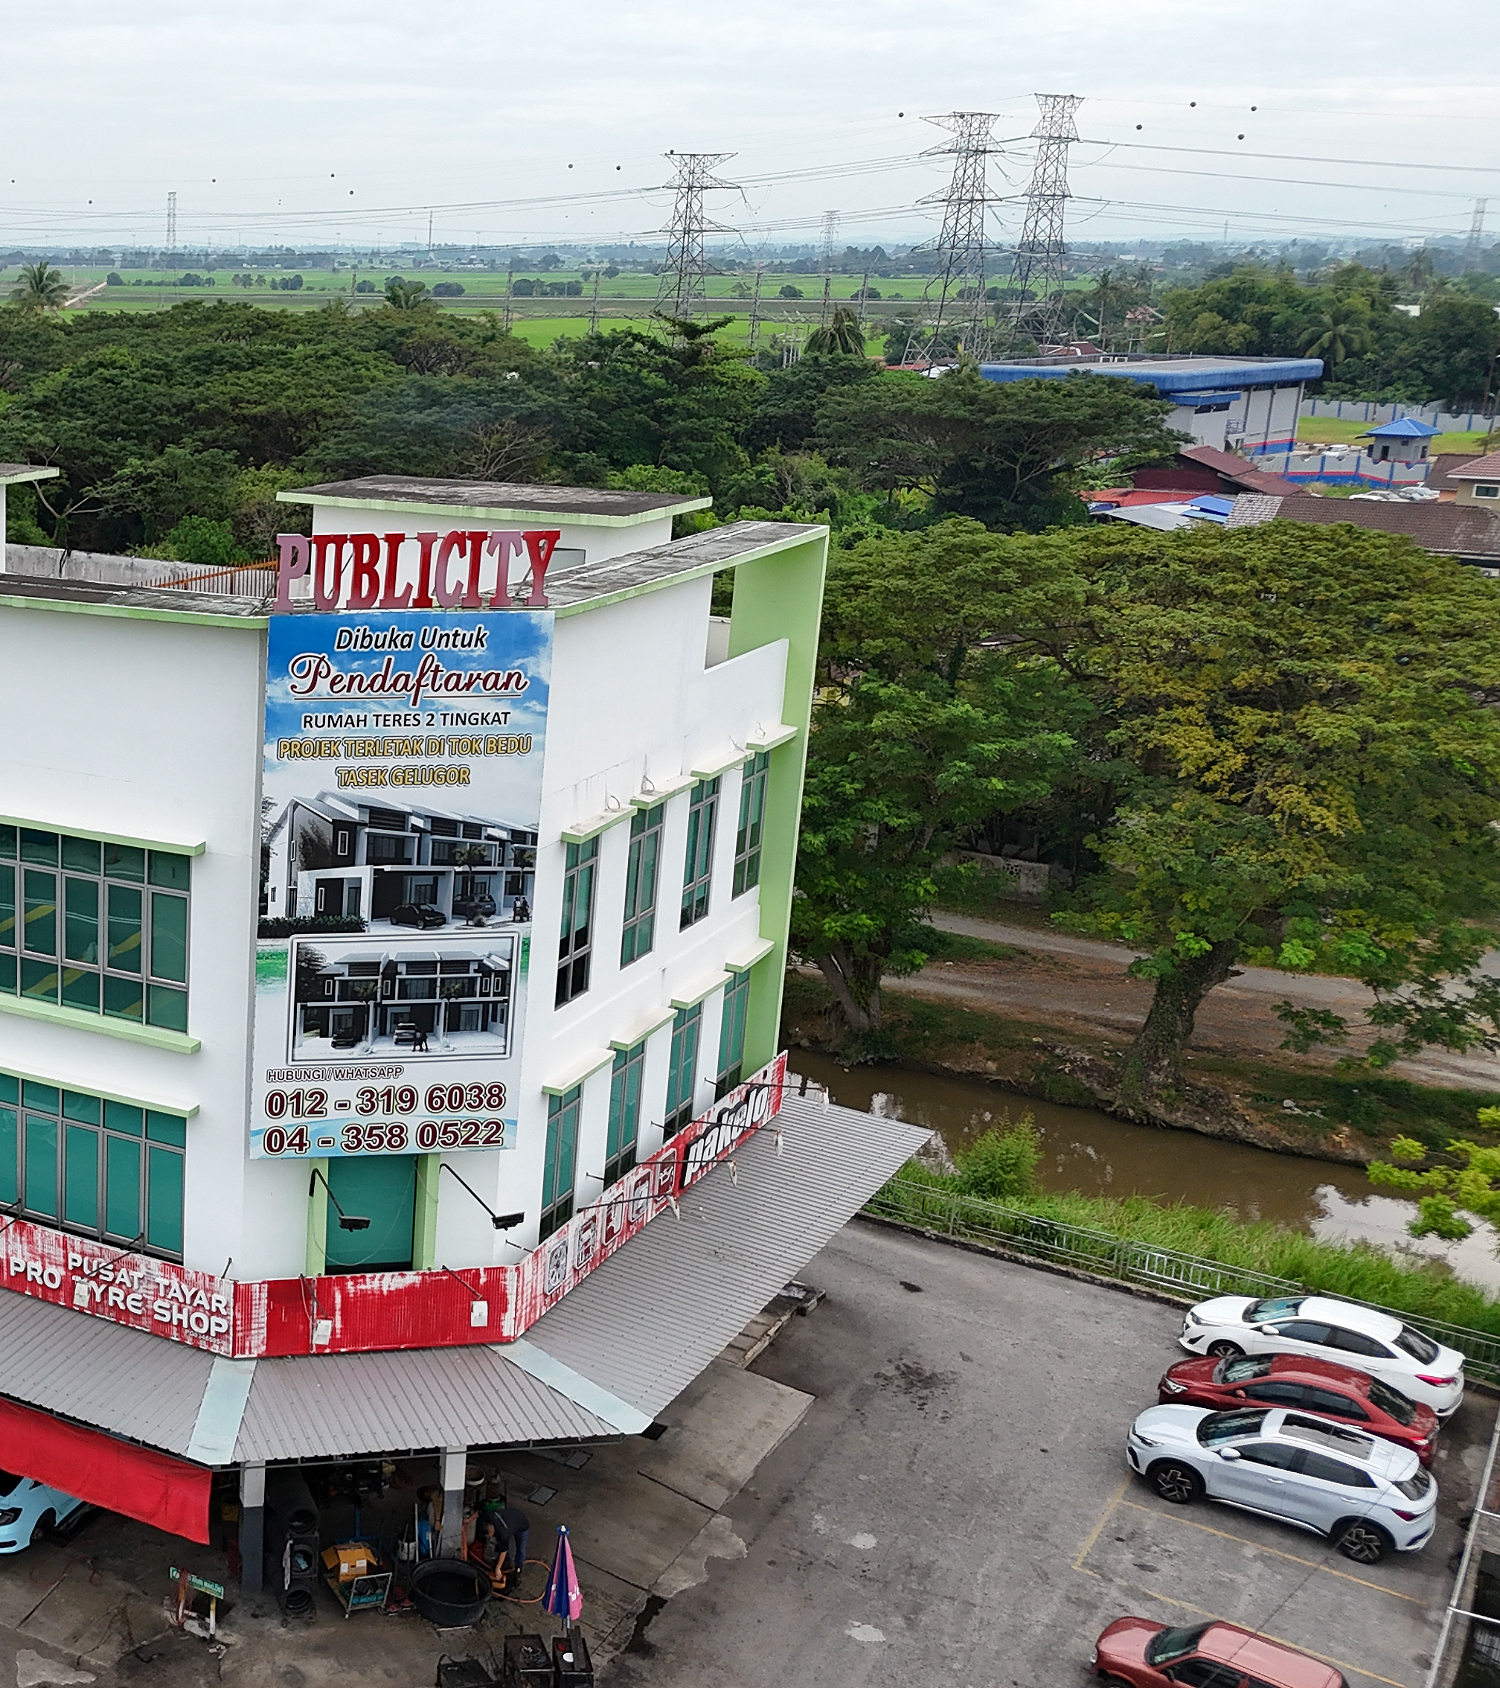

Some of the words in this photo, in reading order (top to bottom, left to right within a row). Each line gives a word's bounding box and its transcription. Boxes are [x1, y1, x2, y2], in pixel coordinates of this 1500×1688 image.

[273, 530, 560, 611] PUBLICITY
[336, 627, 413, 650] Dibuka
[420, 625, 488, 650] Untuk
[289, 653, 528, 707] Pendaftaran
[302, 713, 368, 729] RUMAH
[373, 713, 421, 728] TERES
[425, 713, 435, 727] 2
[440, 711, 511, 727] TINGKAT
[278, 739, 341, 759] PROJEK
[345, 738, 424, 758] TERLETAK
[427, 738, 446, 757] DI
[449, 737, 482, 756] TOK
[486, 735, 532, 755] BEDU
[338, 768, 387, 787] TASEK
[391, 767, 470, 786] GELUGOR
[267, 1068, 325, 1082] HUBUNGI
[334, 1065, 404, 1080] WHATSAPP
[266, 1090, 328, 1117] 012
[357, 1086, 417, 1115] 319
[425, 1083, 505, 1112] 6038
[265, 1126, 309, 1153] 04
[342, 1124, 407, 1151] 358
[417, 1120, 504, 1149] 0522
[682, 1086, 769, 1187] pakelo
[9, 1257, 62, 1290] PRO
[153, 1300, 228, 1337] SHOP
[68, 1252, 143, 1289] PUSAT
[155, 1277, 228, 1316] TAYAR
